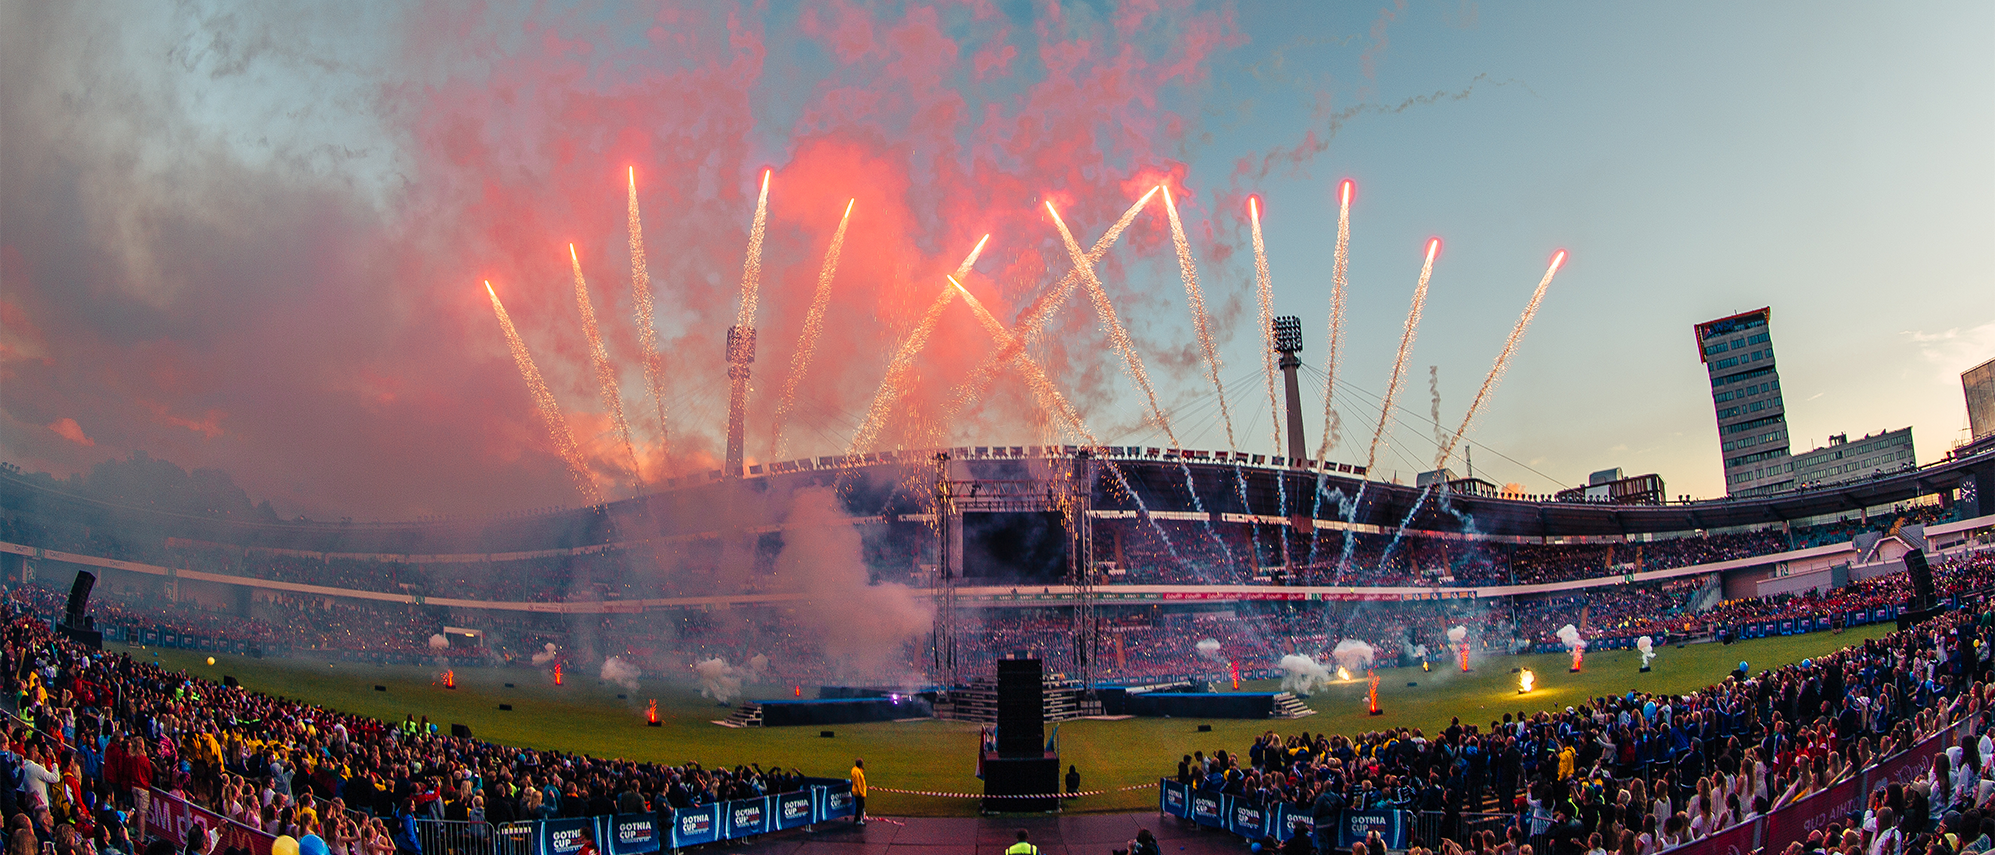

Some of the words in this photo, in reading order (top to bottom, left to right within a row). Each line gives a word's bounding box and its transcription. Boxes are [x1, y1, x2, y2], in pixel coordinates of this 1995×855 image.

[784, 799, 809, 808] GOTHIA
[735, 807, 760, 817] GOTHIA
[784, 806, 798, 816] CUP
[1238, 807, 1260, 819] GOTHIA
[682, 814, 710, 824] GOTHIA
[735, 815, 749, 824] CUP
[1238, 814, 1249, 823] CUP
[1351, 816, 1386, 825] GOTHIA
[619, 821, 652, 832] GOTHIA
[682, 822, 696, 832] CUP
[1351, 824, 1369, 832] CUP
[553, 829, 581, 840] GOTHI
[619, 830, 636, 840] CUP
[553, 838, 572, 848] CUP
